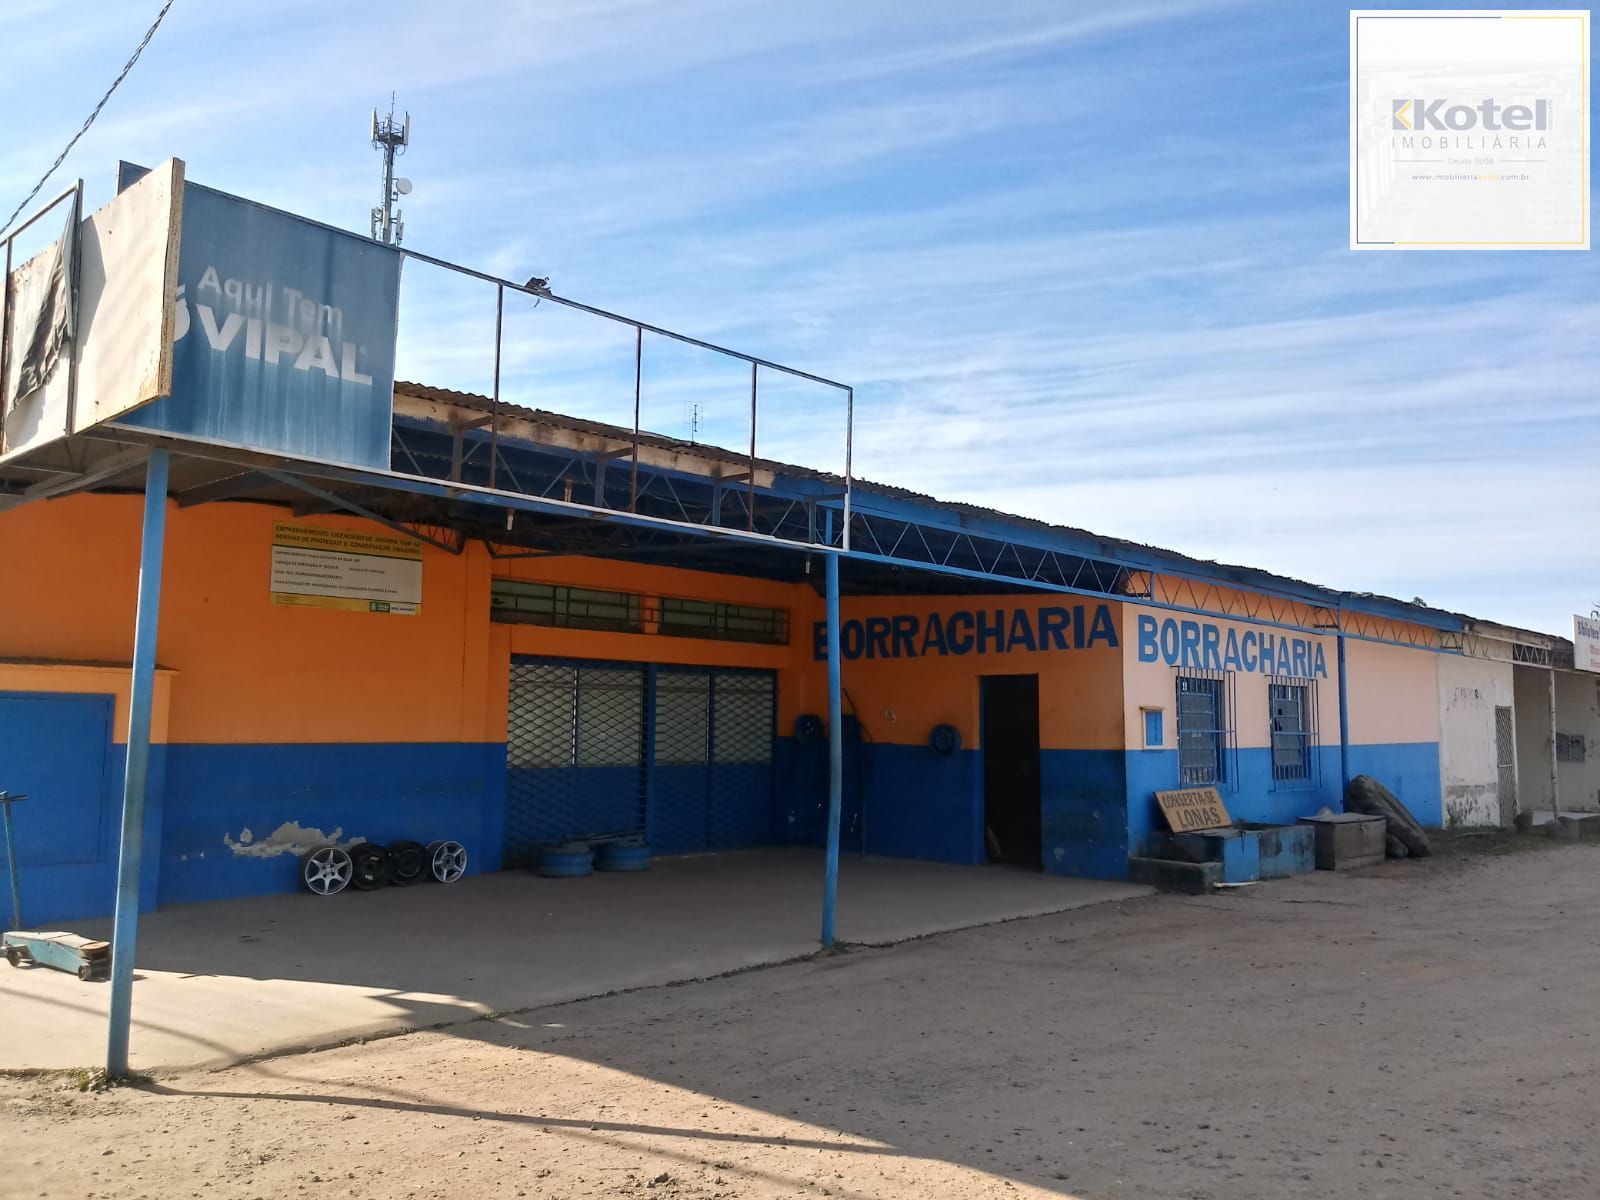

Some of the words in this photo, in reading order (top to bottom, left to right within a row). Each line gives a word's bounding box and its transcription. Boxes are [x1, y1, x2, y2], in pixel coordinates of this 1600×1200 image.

[197, 265, 273, 312] Aqui
[283, 287, 343, 333] Tem
[195, 303, 373, 385] VIPAL
[813, 604, 1119, 662] BORRACHARIA
[1137, 614, 1328, 679] BORRACHARIA
[1176, 807, 1222, 828] LONAS
